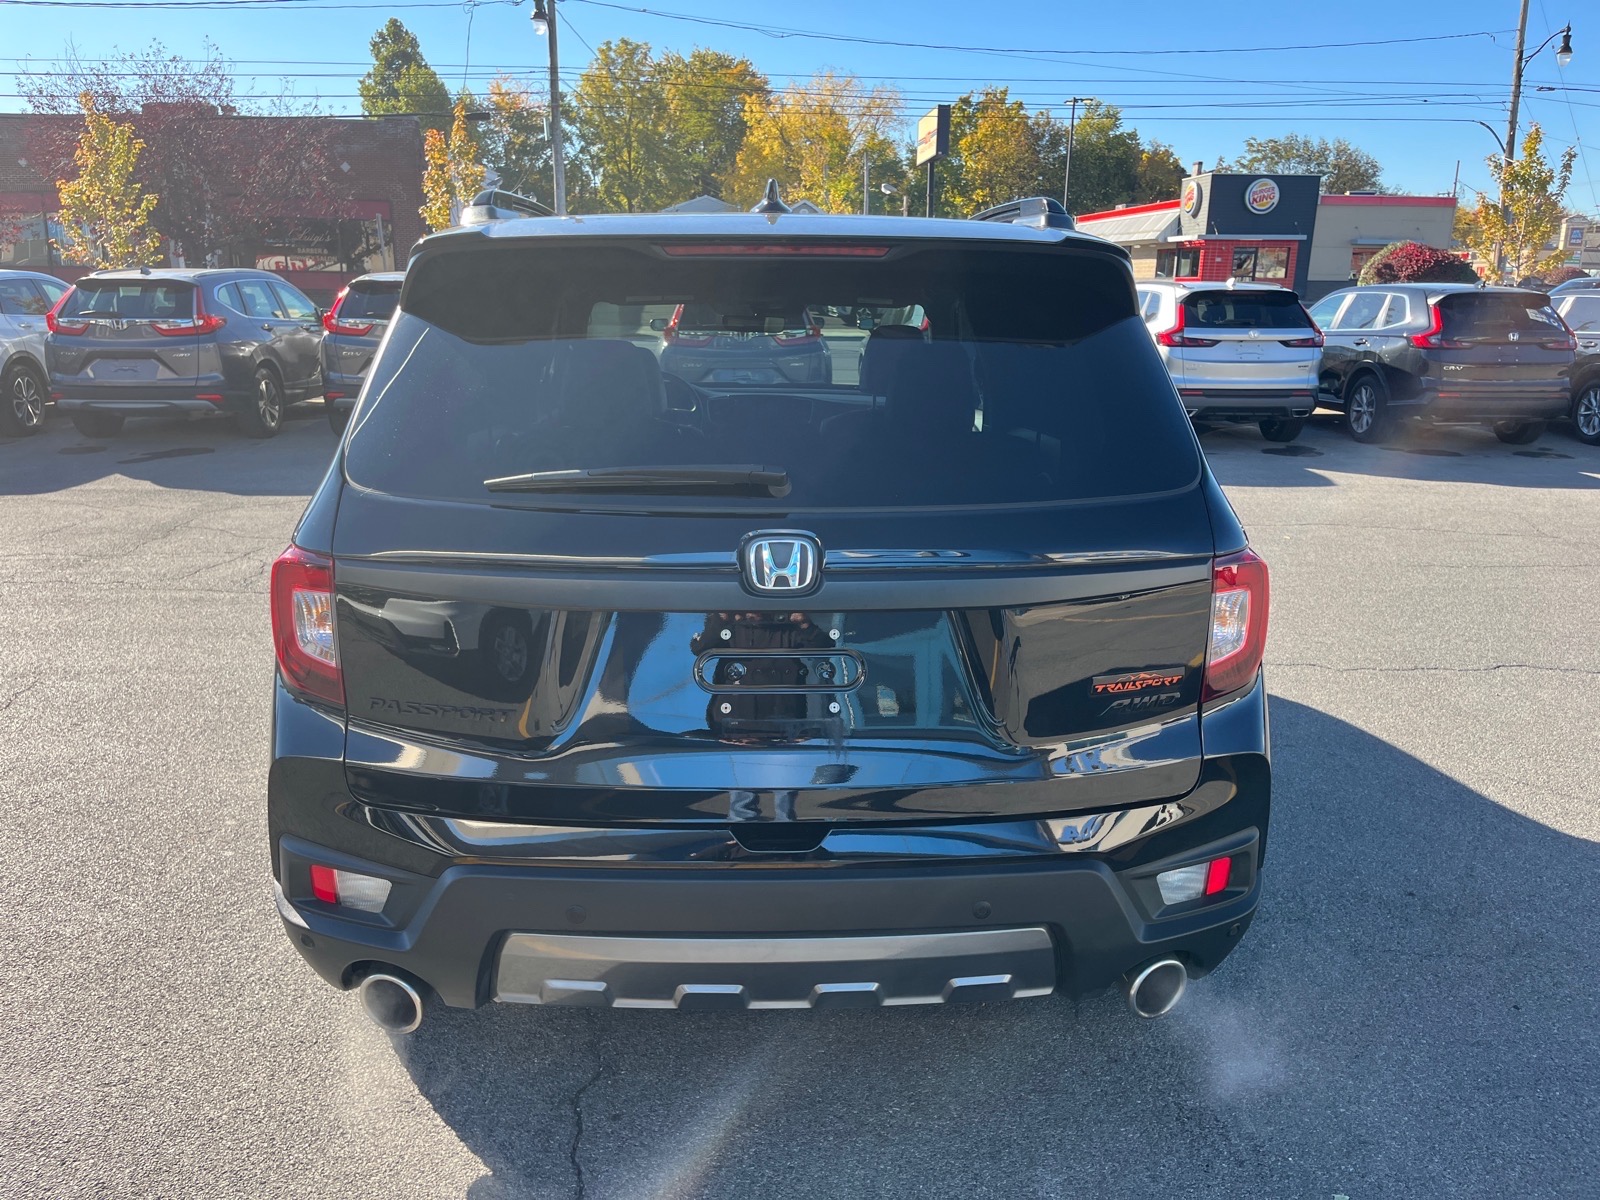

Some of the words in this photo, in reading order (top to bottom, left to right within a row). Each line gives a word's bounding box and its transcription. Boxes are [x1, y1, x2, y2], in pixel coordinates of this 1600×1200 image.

[1251, 187, 1275, 196] BURGER
[1251, 193, 1275, 205] KING
[1094, 675, 1183, 694] TRAILSPORT
[369, 697, 517, 723] PASSPORT
